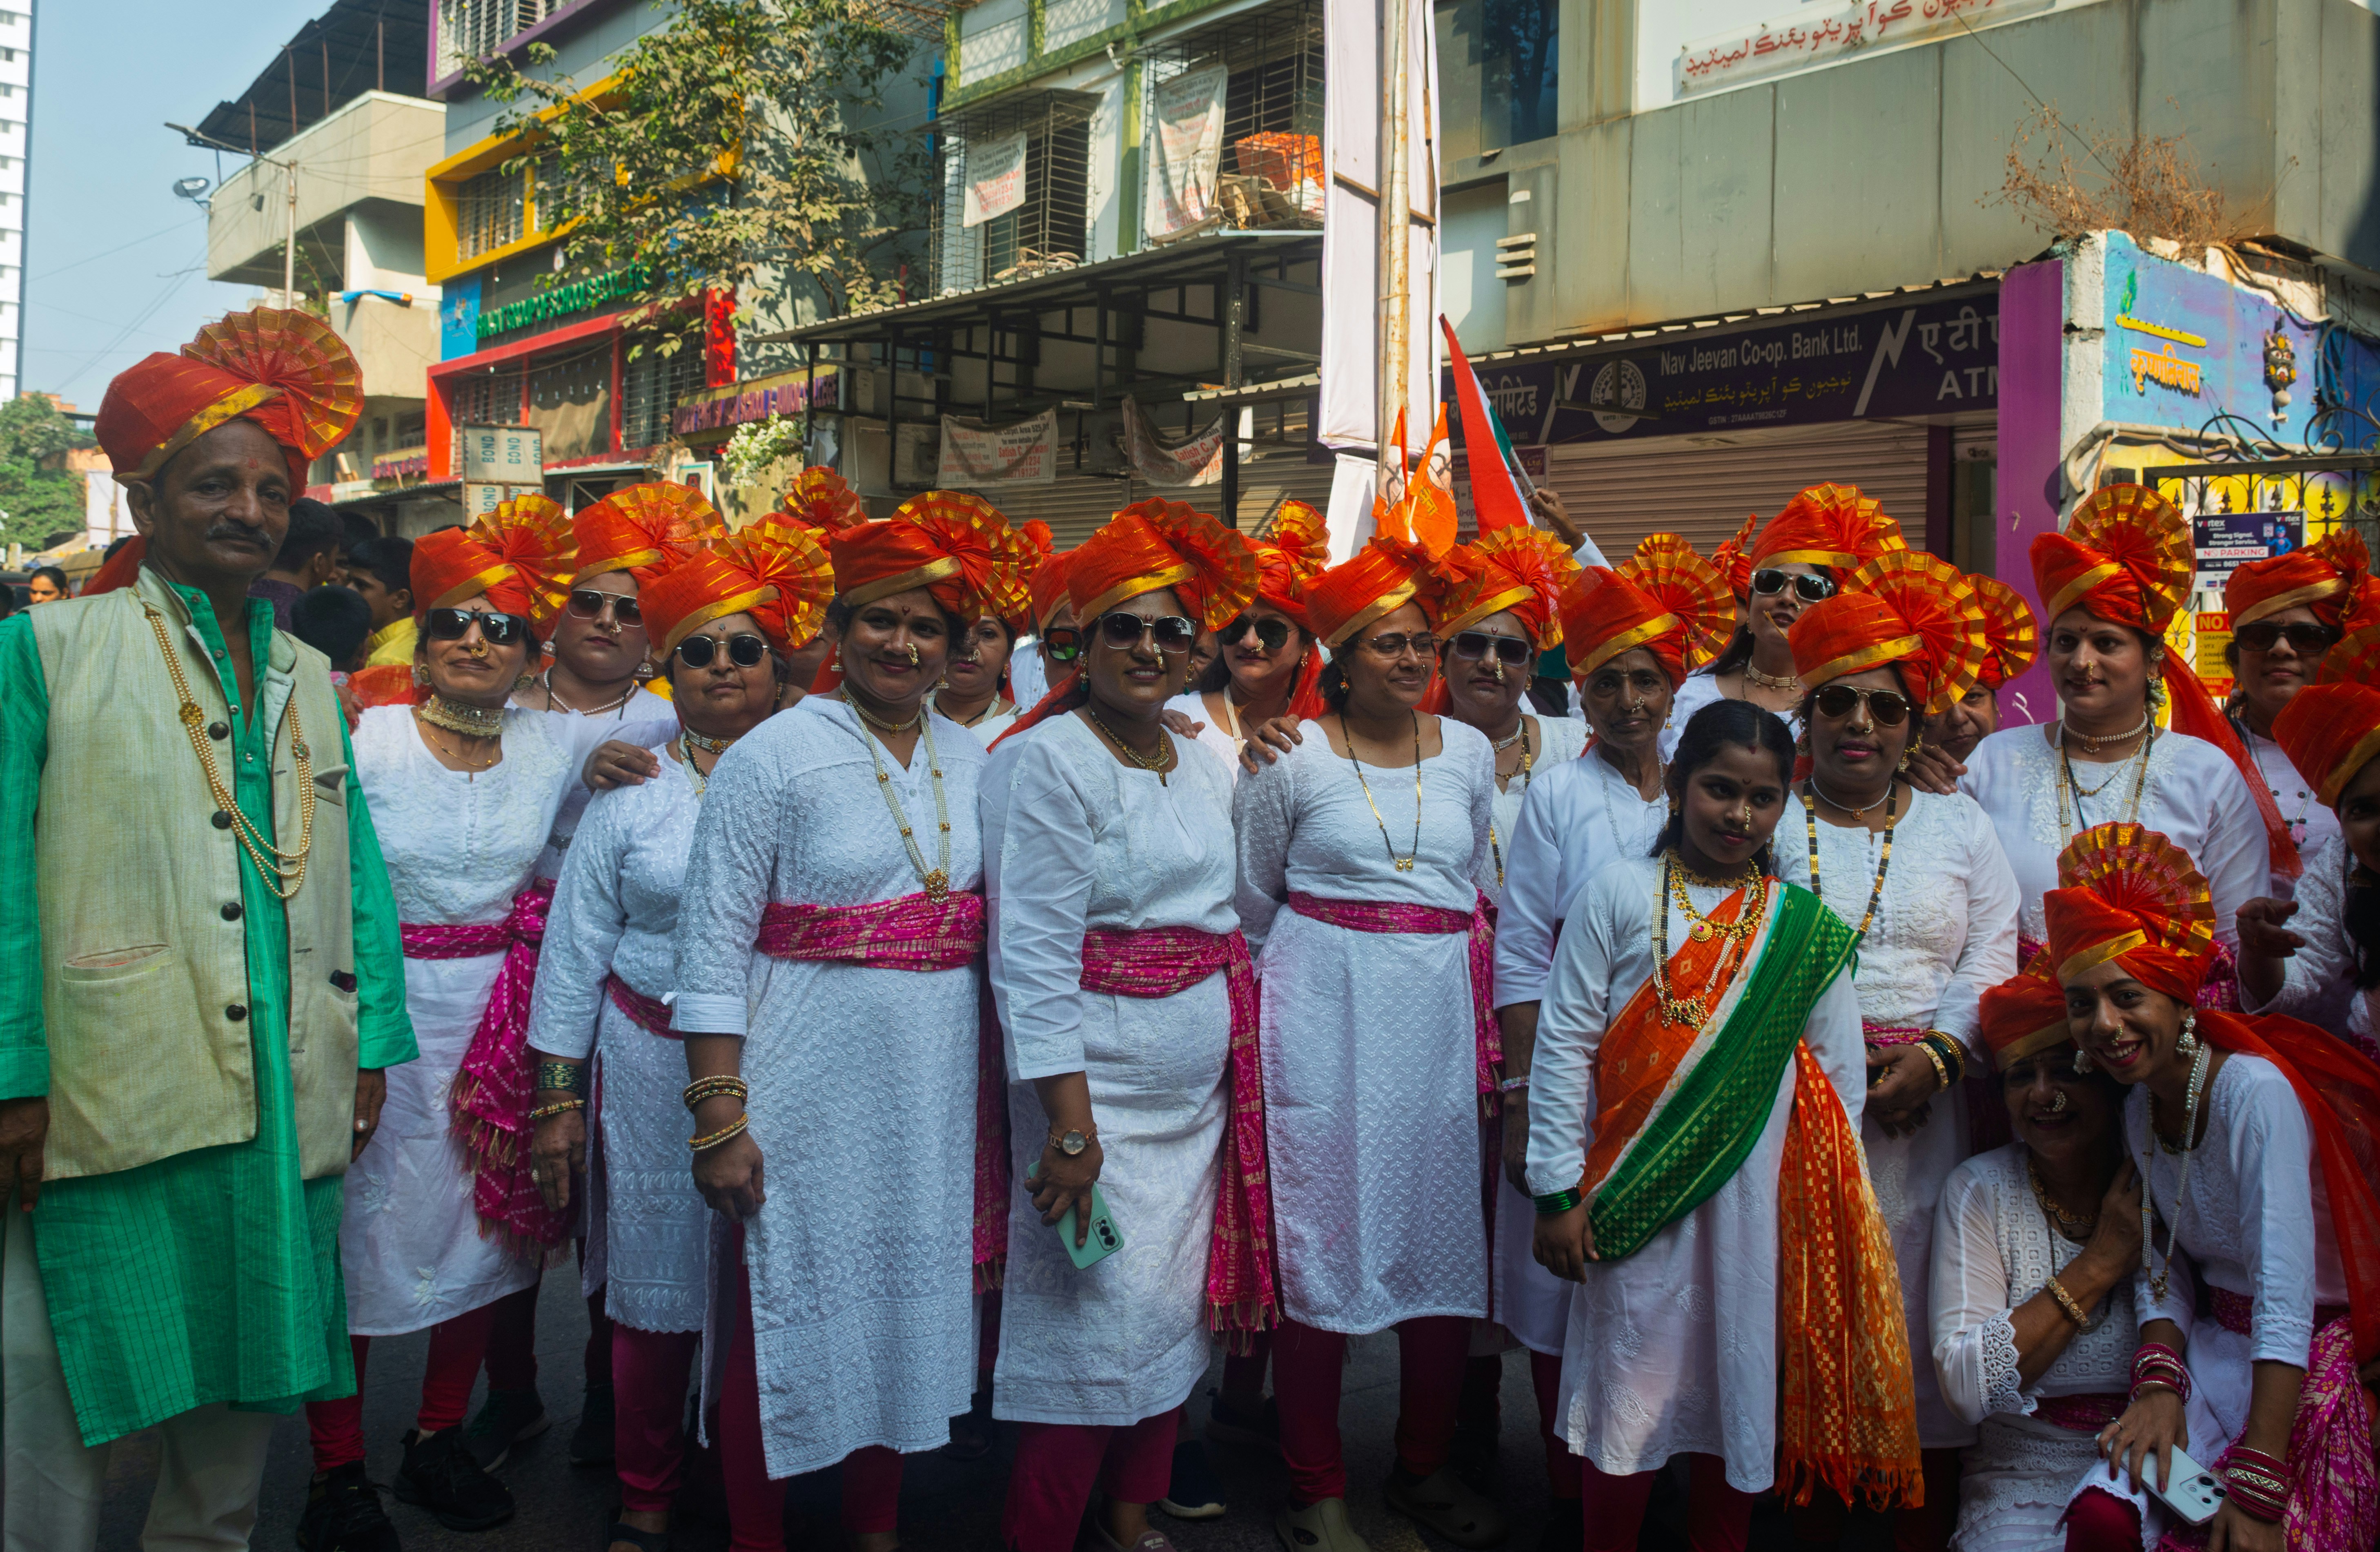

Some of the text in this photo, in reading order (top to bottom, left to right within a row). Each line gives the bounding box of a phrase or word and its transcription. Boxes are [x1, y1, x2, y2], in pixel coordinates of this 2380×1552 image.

[1661, 325, 1863, 376] Nav Jeevan Co-op. Bank Ltd.
[1708, 417, 1727, 426] GSTIN
[481, 436, 495, 462] BOND
[1174, 445, 1201, 462] Satish
[2220, 547, 2265, 557] PARKING
[2199, 617, 2224, 630] NO
